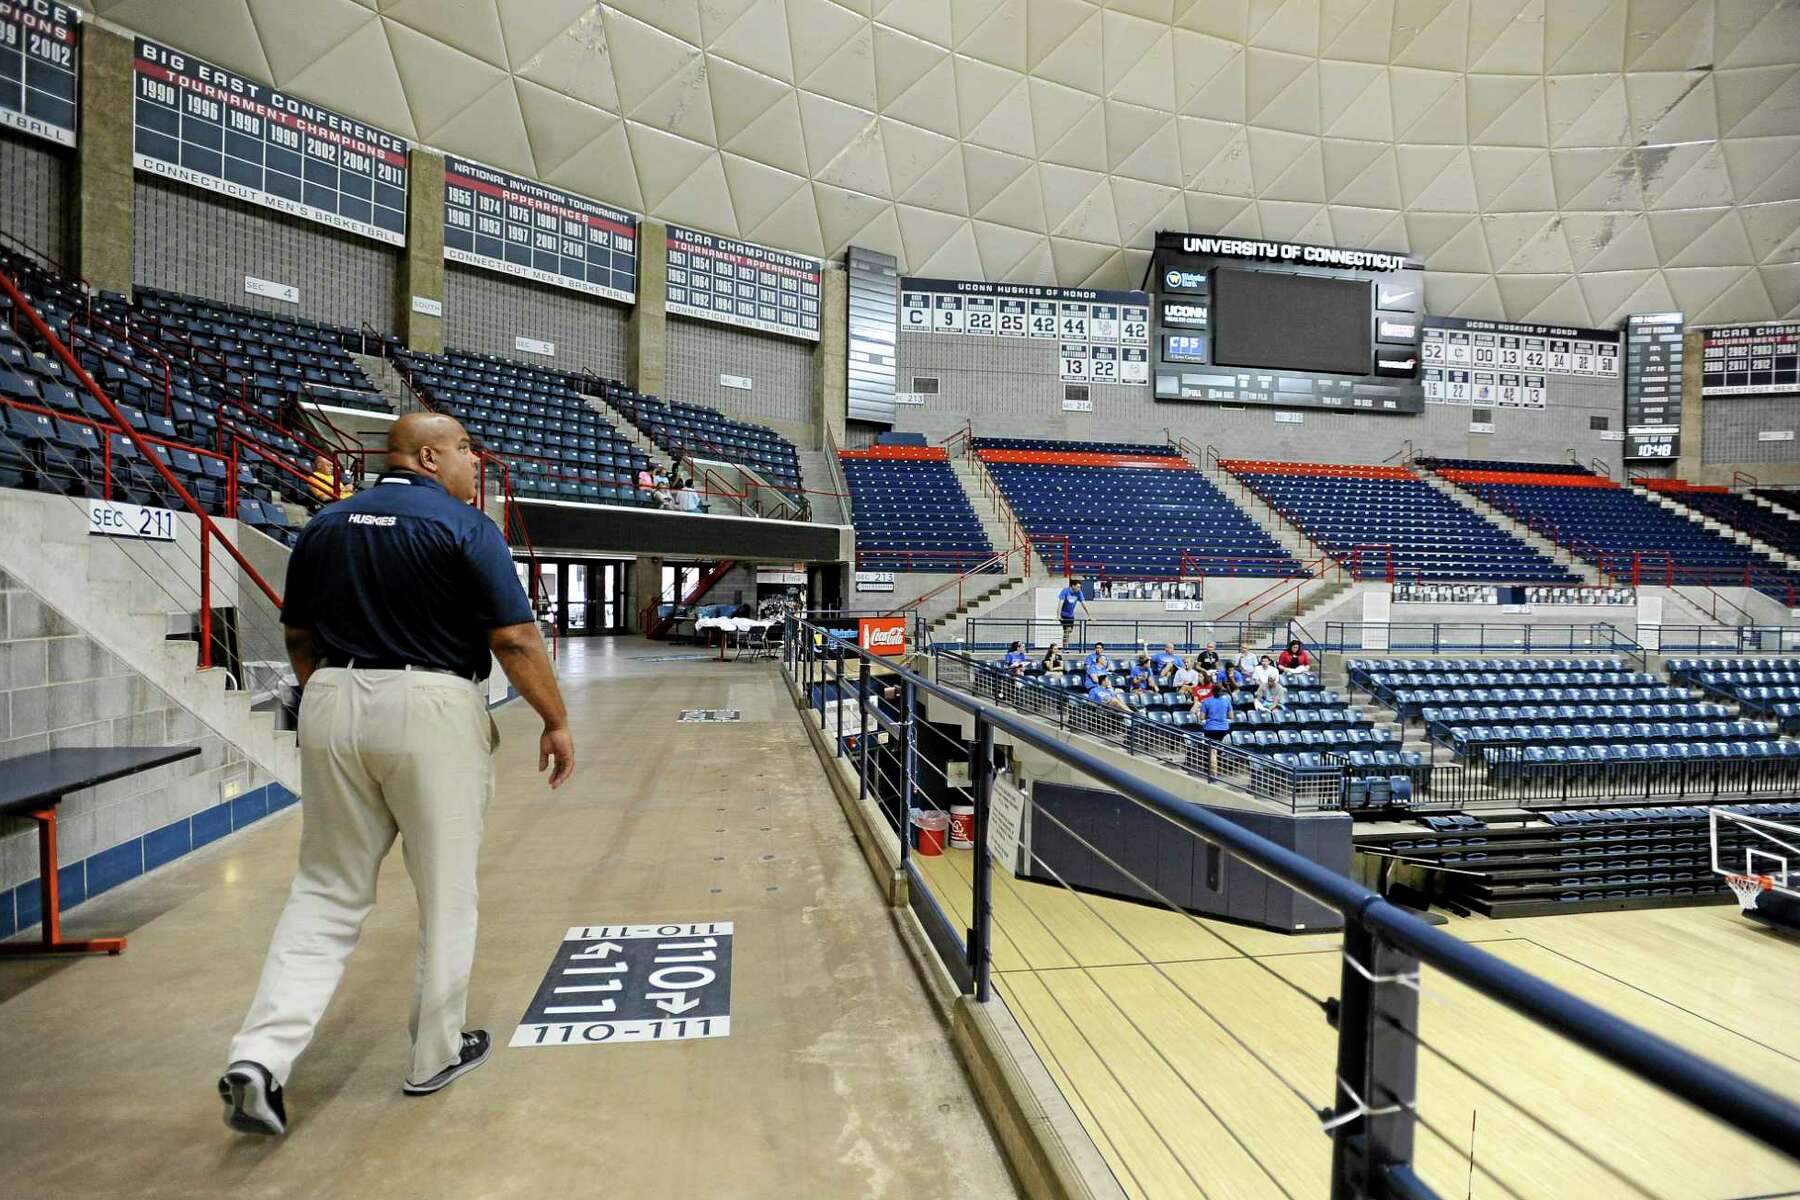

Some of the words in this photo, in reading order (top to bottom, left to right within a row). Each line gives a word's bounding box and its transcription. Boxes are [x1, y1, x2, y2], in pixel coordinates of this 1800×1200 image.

[30, 34, 71, 67] 2002
[143, 44, 184, 71] BIG
[198, 65, 259, 98] EAST
[271, 93, 402, 153] CONFERENCE
[166, 70, 289, 123] TOURNAMENT
[296, 118, 386, 159] CHAMPIONS
[142, 77, 175, 105] 1990
[187, 94, 218, 121] 1996
[230, 110, 260, 136] 1998
[270, 124, 299, 149] 1999
[307, 138, 336, 162] 2002
[343, 150, 370, 174] 2004
[378, 163, 402, 185] 2011
[454, 162, 507, 187] NATIONAL
[509, 180, 565, 204] INVITATION
[568, 197, 629, 223] TOURNAMENT
[143, 158, 258, 200] CONNECTICUT
[264, 196, 309, 217] MEN'S
[314, 211, 399, 243] BASKETBALL
[448, 186, 472, 206] 1955
[479, 195, 500, 215] 1974
[508, 204, 530, 223] 1975
[502, 190, 589, 222] APPEARANCES
[508, 224, 529, 242] 1997
[536, 232, 557, 250] 2001
[562, 240, 584, 258] 2010
[675, 229, 711, 247] NCAA
[718, 239, 813, 270] CHAMPIONSHIP
[1183, 237, 1278, 258] UNIVERSITY
[1280, 244, 1302, 260] OF
[1303, 246, 1406, 270] CONNECTICUT
[674, 240, 742, 263] TOURNAMENT
[746, 258, 814, 281] APPEARANCES
[449, 249, 527, 275] CONNECTICUT
[568, 279, 630, 301] BASKETBALL
[246, 281, 265, 291] SEC
[283, 289, 292, 299] 4
[958, 283, 993, 292] UCONN
[998, 284, 1041, 295] HUSKIES
[1063, 290, 1097, 299] HONOR
[414, 300, 440, 311] SOUTH
[669, 303, 730, 322] CONNECTICUT
[1164, 304, 1208, 318] UCONN
[910, 310, 923, 324] C
[945, 312, 953, 326] 9
[970, 313, 991, 328] 22
[1001, 315, 1023, 330] 25
[1033, 318, 1054, 332] 42
[1064, 319, 1085, 334] 44
[1124, 323, 1145, 338] 42
[1466, 321, 1496, 330] UCONN
[1712, 328, 1750, 338] NCAA
[543, 344, 550, 352] 5
[1711, 336, 1780, 346] TOURNAMENT
[1425, 344, 1442, 358] 52
[1476, 349, 1493, 361] 00
[1503, 350, 1517, 363] 13
[1526, 352, 1543, 366] 42
[1066, 360, 1082, 374] 13
[1095, 361, 1114, 376] 22
[1638, 444, 1672, 457] 10:48
[93, 508, 124, 528] SEC
[140, 508, 172, 537] 211
[348, 513, 397, 526] HUSKIES
[1184, 601, 1201, 610] 214
[581, 924, 720, 939] 110-111
[648, 937, 718, 990] 110
[543, 961, 629, 1014] 111
[534, 1019, 711, 1044] 110-111
